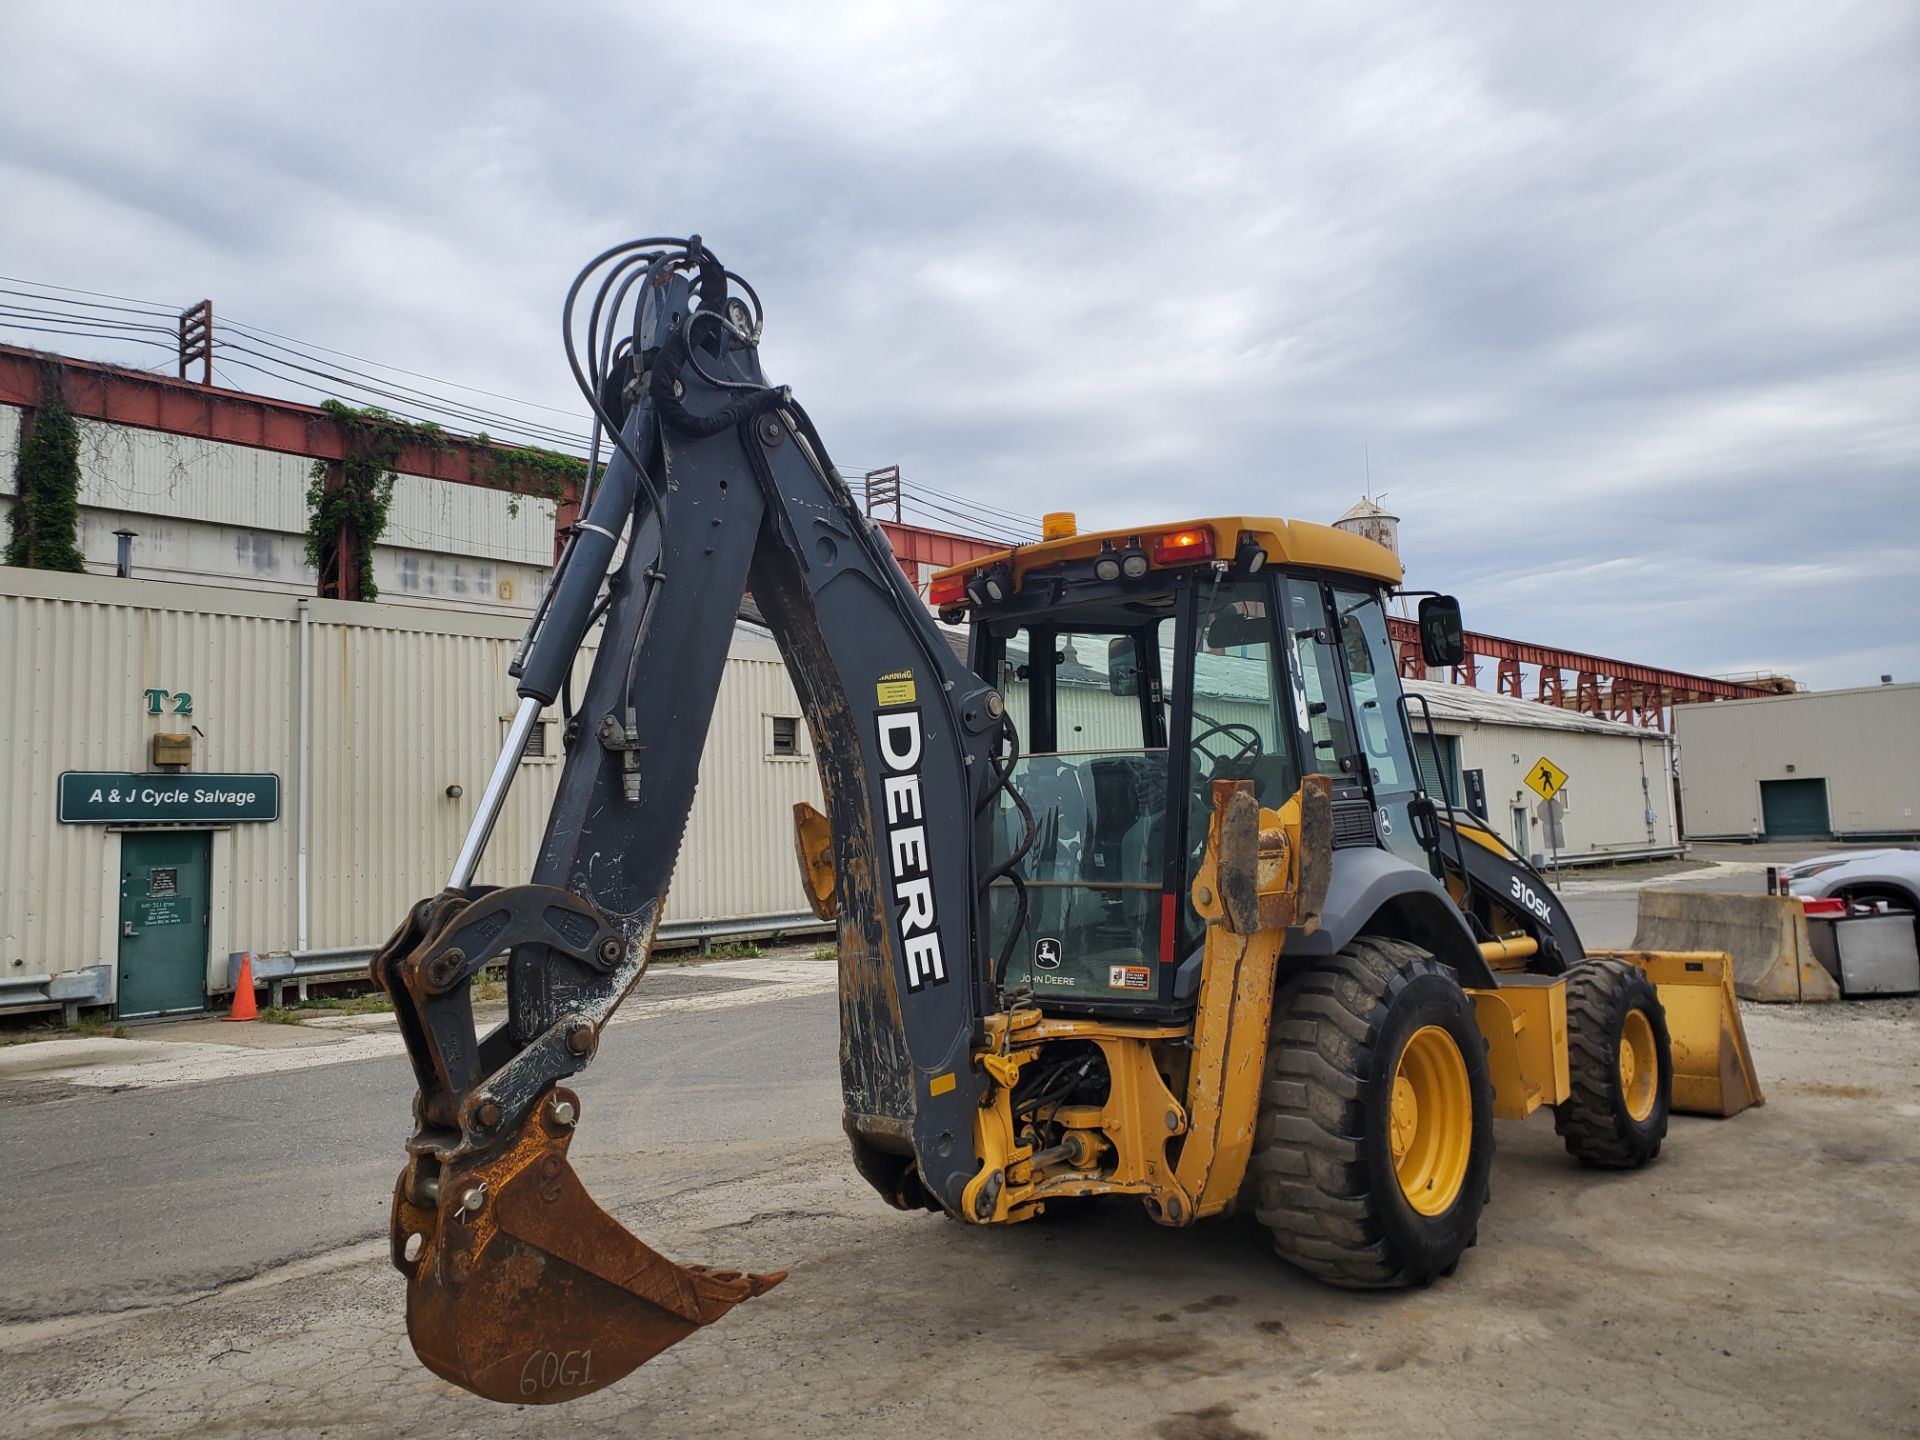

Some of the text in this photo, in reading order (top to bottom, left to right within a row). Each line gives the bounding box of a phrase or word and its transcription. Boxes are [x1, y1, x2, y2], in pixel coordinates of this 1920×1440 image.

[144, 688, 193, 716] T2
[88, 788, 256, 806] A & J Cycle Salvage
[877, 710, 945, 988] DEERE
[1511, 876, 1551, 925] 310SK
[1019, 973, 1075, 986] JOHN DEERE
